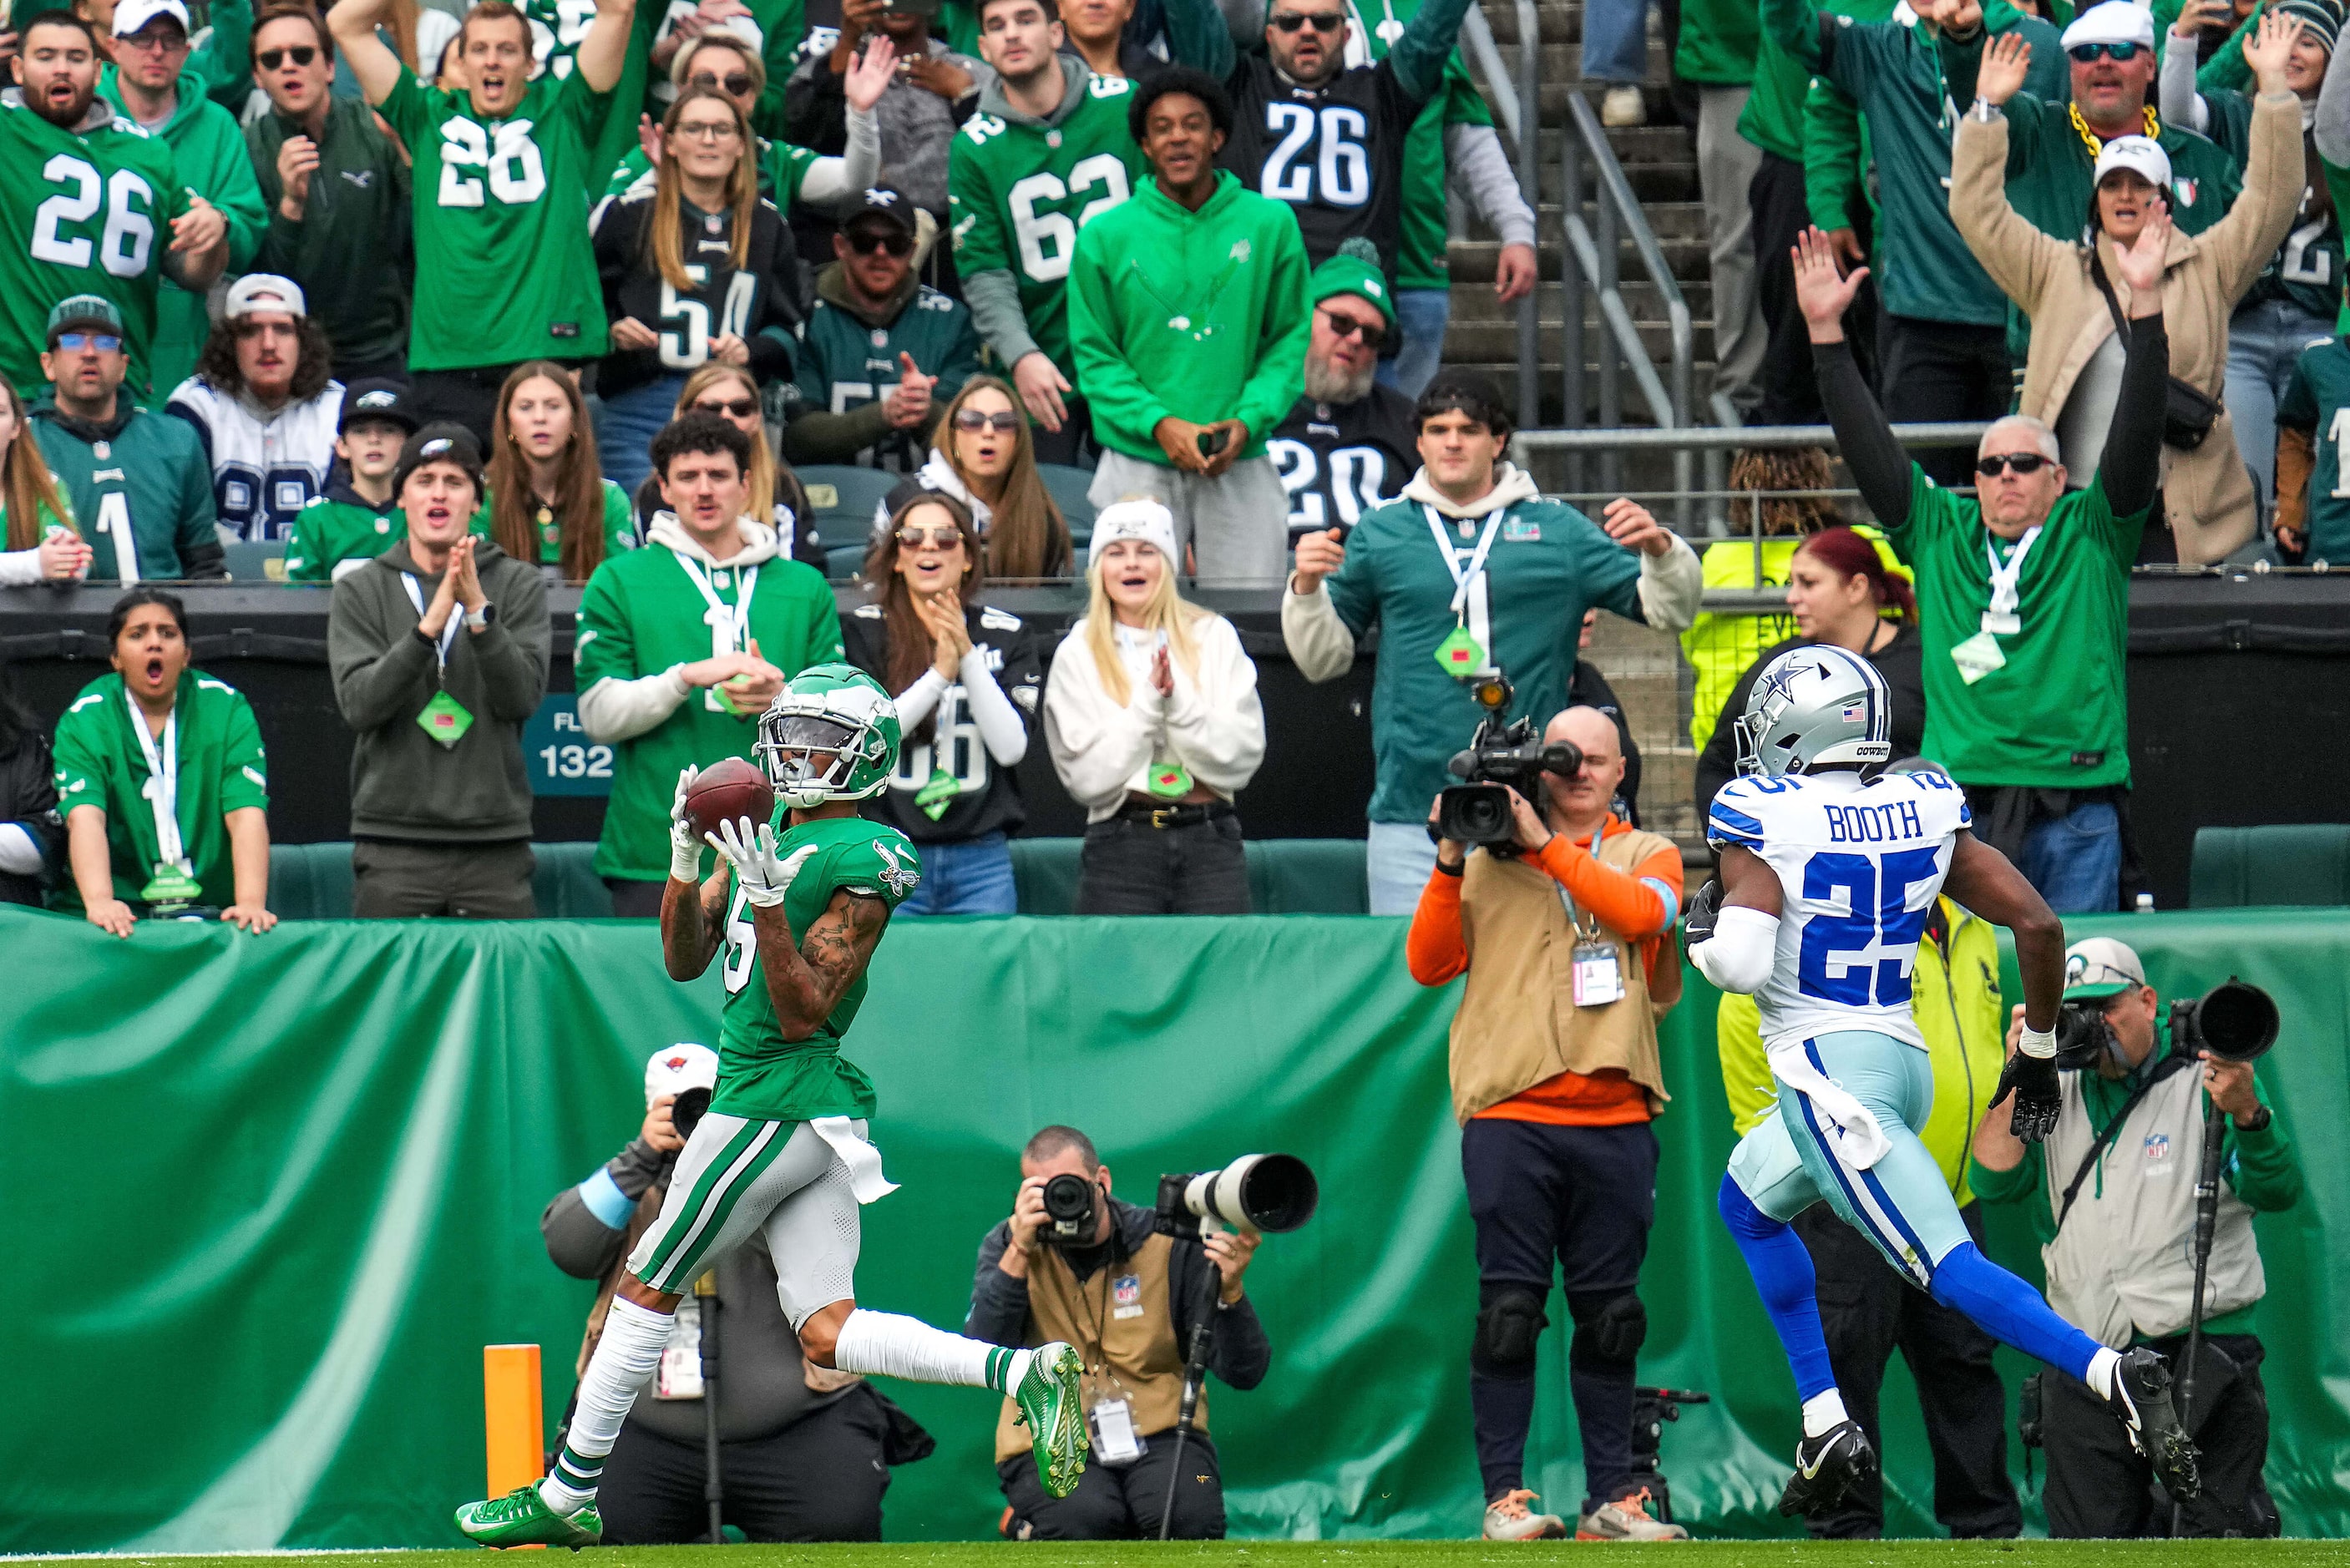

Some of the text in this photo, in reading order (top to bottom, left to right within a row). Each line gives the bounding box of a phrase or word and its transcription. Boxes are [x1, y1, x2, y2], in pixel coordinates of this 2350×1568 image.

[438, 115, 547, 207] 26
[1260, 101, 1370, 205] 26
[30, 153, 154, 280] 26
[96, 491, 140, 584] 1
[539, 744, 614, 778] 132
[1824, 800, 1923, 842] BOOTH
[1798, 844, 1942, 1008] 25
